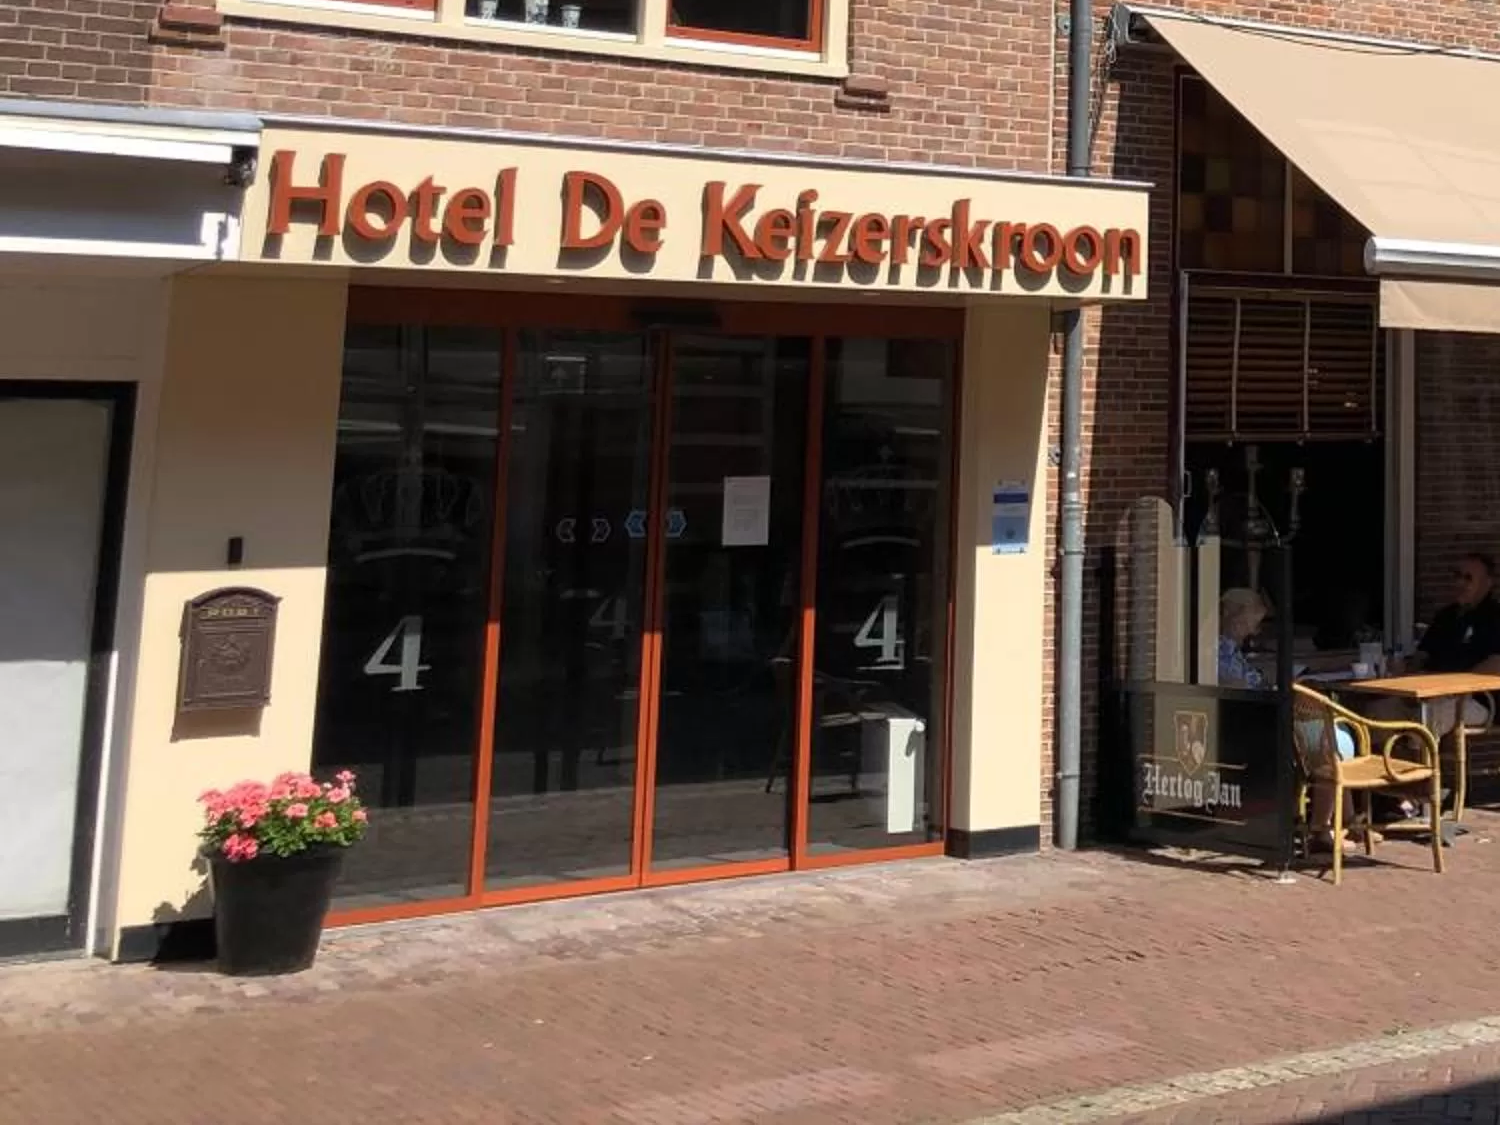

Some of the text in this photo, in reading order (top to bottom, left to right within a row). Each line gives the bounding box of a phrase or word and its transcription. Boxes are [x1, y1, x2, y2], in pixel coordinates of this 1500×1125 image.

[268, 149, 1142, 276] Hotel De Keizerskroon
[363, 615, 432, 691] 4
[854, 595, 905, 663] 4
[1142, 762, 1242, 814] Hertog Jan
